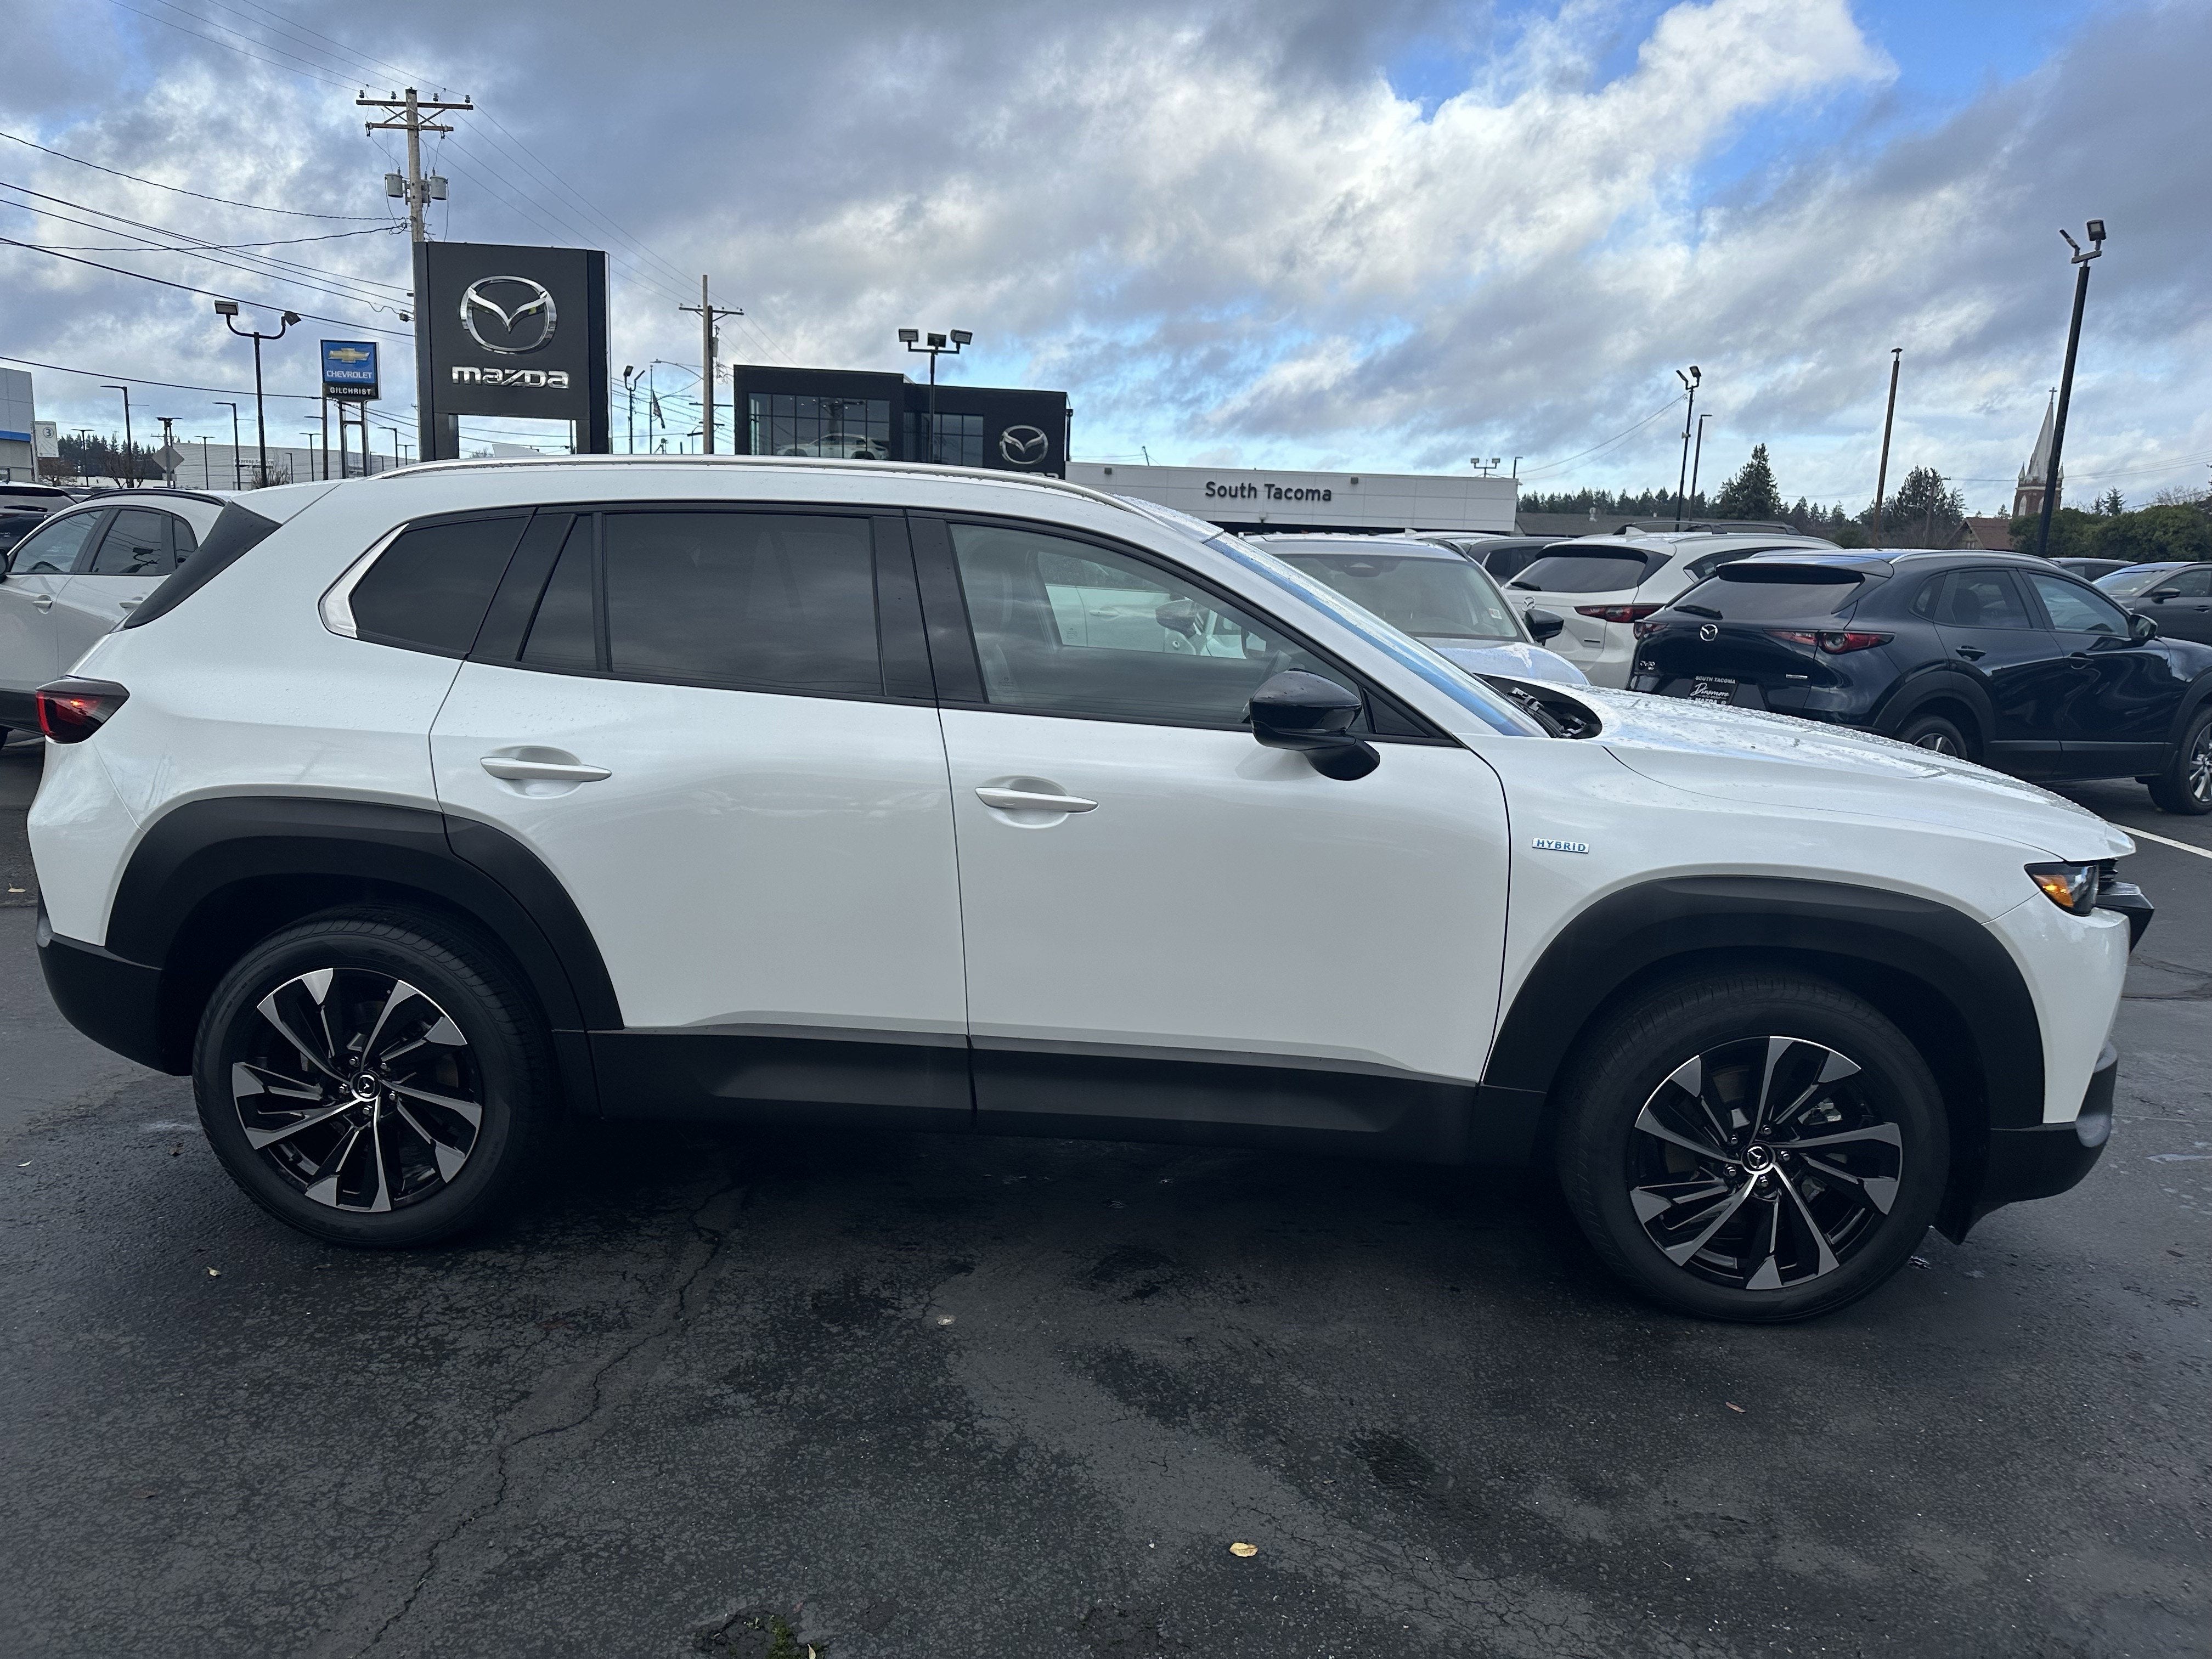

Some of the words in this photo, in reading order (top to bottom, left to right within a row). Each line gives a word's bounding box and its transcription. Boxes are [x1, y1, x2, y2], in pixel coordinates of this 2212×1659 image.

[326, 370, 373, 379] CHEVROLET
[330, 387, 371, 395] GILCHRIST
[46, 428, 52, 437] 3
[1205, 481, 1257, 499] South
[1264, 483, 1332, 501] Tacoma
[1536, 839, 1586, 851] HYBRID
